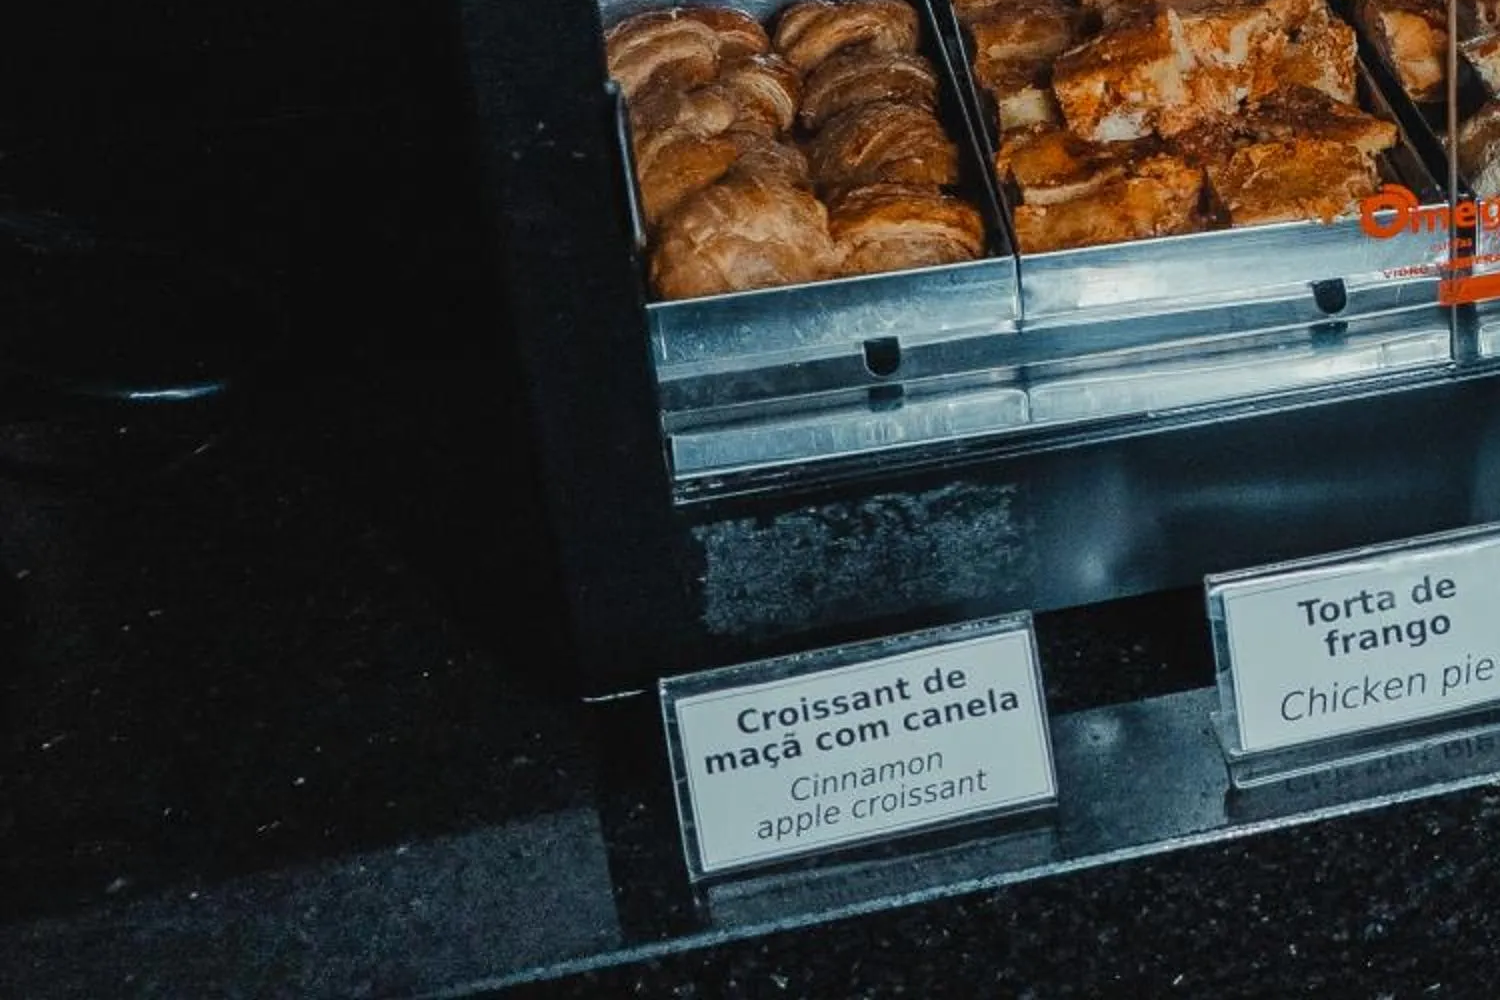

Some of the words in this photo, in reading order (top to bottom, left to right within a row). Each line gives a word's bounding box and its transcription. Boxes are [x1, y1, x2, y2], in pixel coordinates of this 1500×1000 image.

[1297, 588, 1396, 626] Torta
[1411, 575, 1456, 603] de
[1324, 614, 1451, 656] frango
[738, 678, 909, 735] Croissant
[923, 668, 966, 694] de
[1281, 673, 1426, 721] Chicken
[1442, 654, 1494, 696] pie
[705, 733, 802, 774] maçã
[816, 718, 889, 750] com
[903, 689, 1019, 731] canela
[757, 804, 840, 840] apple
[852, 769, 988, 818] croissant
[791, 751, 943, 802] Cinnamon
